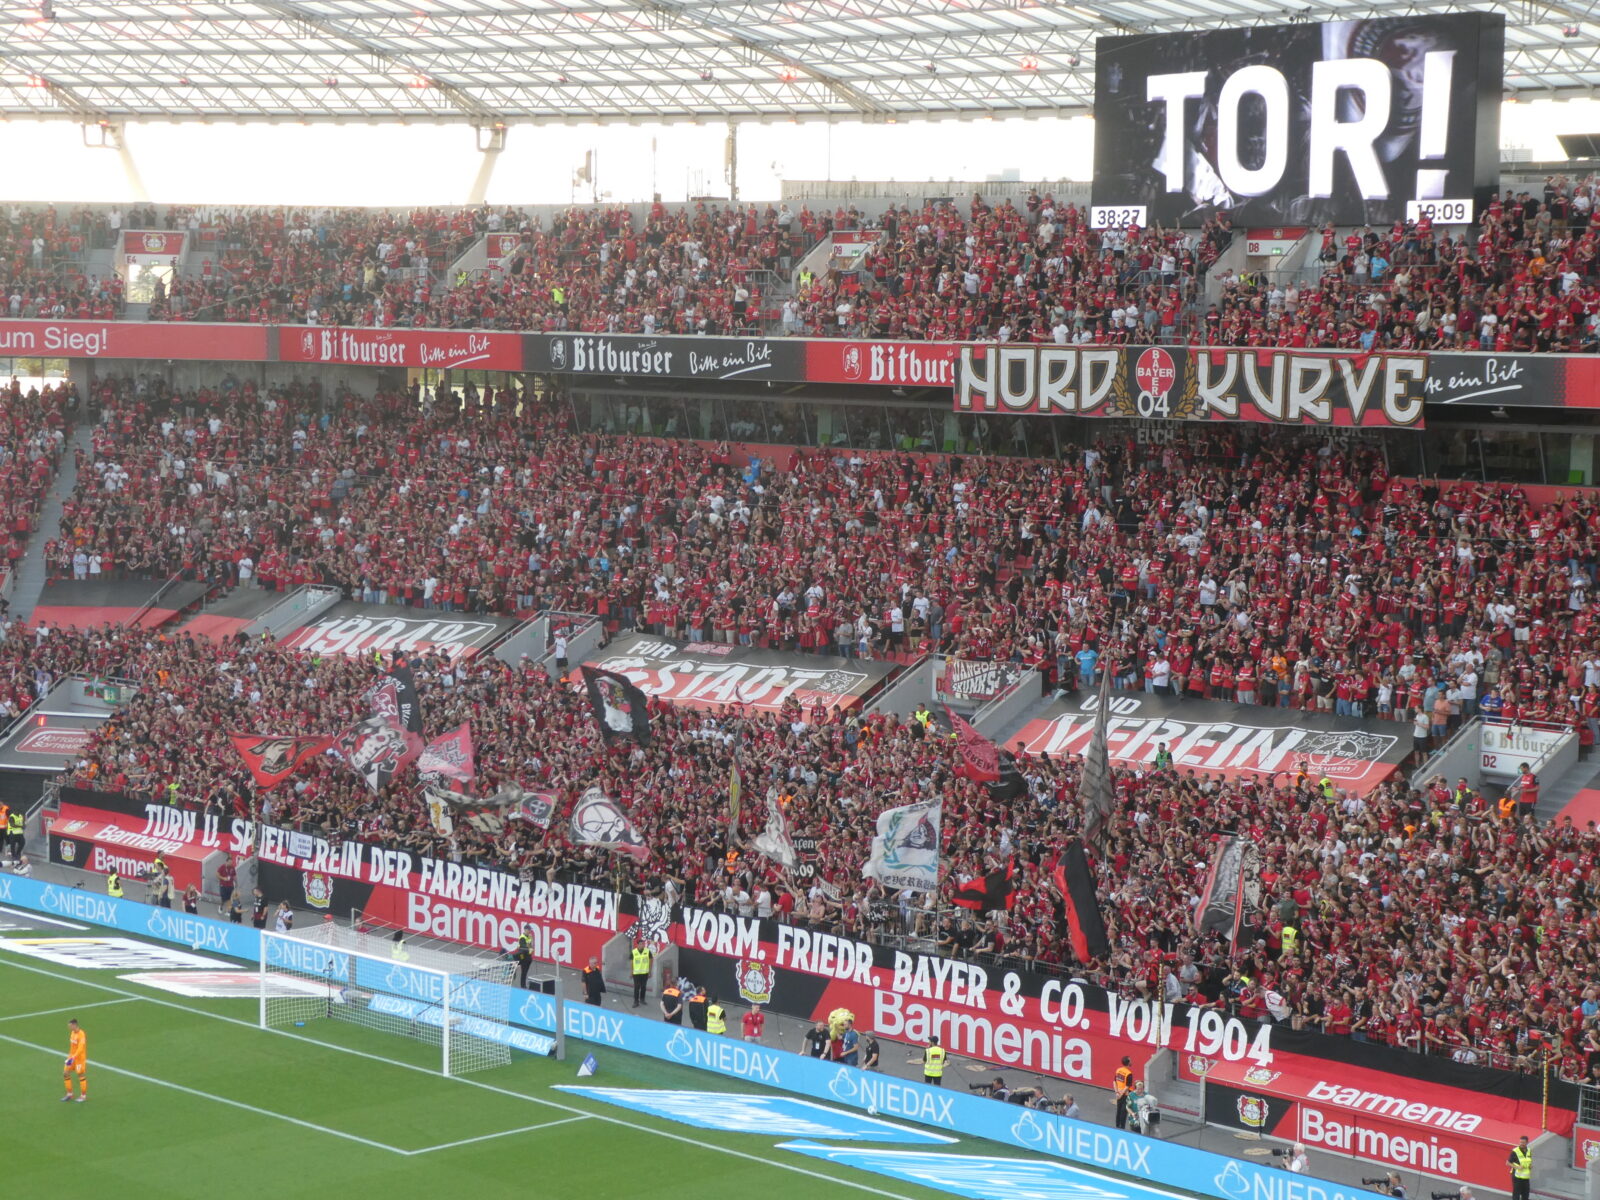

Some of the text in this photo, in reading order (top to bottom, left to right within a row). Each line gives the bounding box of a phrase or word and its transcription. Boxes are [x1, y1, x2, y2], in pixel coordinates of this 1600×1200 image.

[1146, 50, 1458, 200] TOR!
[1098, 210, 1140, 225] 38:27
[1417, 203, 1465, 220] 19:09
[1249, 243, 1260, 253] D8
[44, 327, 107, 355] Sieg!
[321, 330, 405, 364] Bitburger
[421, 343, 446, 364] Bitte
[448, 344, 468, 358] ein
[573, 337, 672, 374] Bitburger
[690, 351, 719, 374] Bitte
[722, 352, 745, 368] ein
[869, 344, 954, 384] Bitbur
[959, 346, 1119, 411] NORD
[1137, 367, 1173, 378] BAYER
[1152, 350, 1160, 395] BAYER
[1448, 371, 1482, 389] ein
[1486, 358, 1524, 384] Bit
[1137, 390, 1170, 418] 04
[1196, 351, 1427, 424] KURVE
[627, 639, 677, 659] FÜR
[641, 661, 826, 704] STADT
[1079, 694, 1142, 715] UND
[1048, 715, 1308, 770] VEREIN
[1500, 731, 1556, 755] Bitburg
[1482, 754, 1497, 768] D2
[94, 824, 184, 853] Barmenia
[95, 847, 155, 878] Barmen
[59, 892, 118, 925] NIEDAX
[145, 803, 1274, 1067] TURN U. SPIELREIN DER FARBENFABRIKEN VORM. FRIEDR. BAYER & CO. VON 1904
[168, 916, 230, 951] NIEDAX
[408, 891, 572, 964] Barmenia
[276, 941, 350, 979] NIEDAX
[410, 973, 482, 1010] NIEDAX
[508, 1029, 550, 1053] NIEDAX
[547, 1002, 624, 1045] NIEDAX
[873, 989, 1093, 1080] Barmenia
[695, 1035, 780, 1084] NIEDAX
[860, 1076, 954, 1127] NIEDAX
[1306, 1081, 1482, 1133] Barmenia
[1045, 1120, 1152, 1176] NIEDAX
[1302, 1107, 1458, 1175] Barmenia
[1254, 1171, 1358, 1200] NIED
